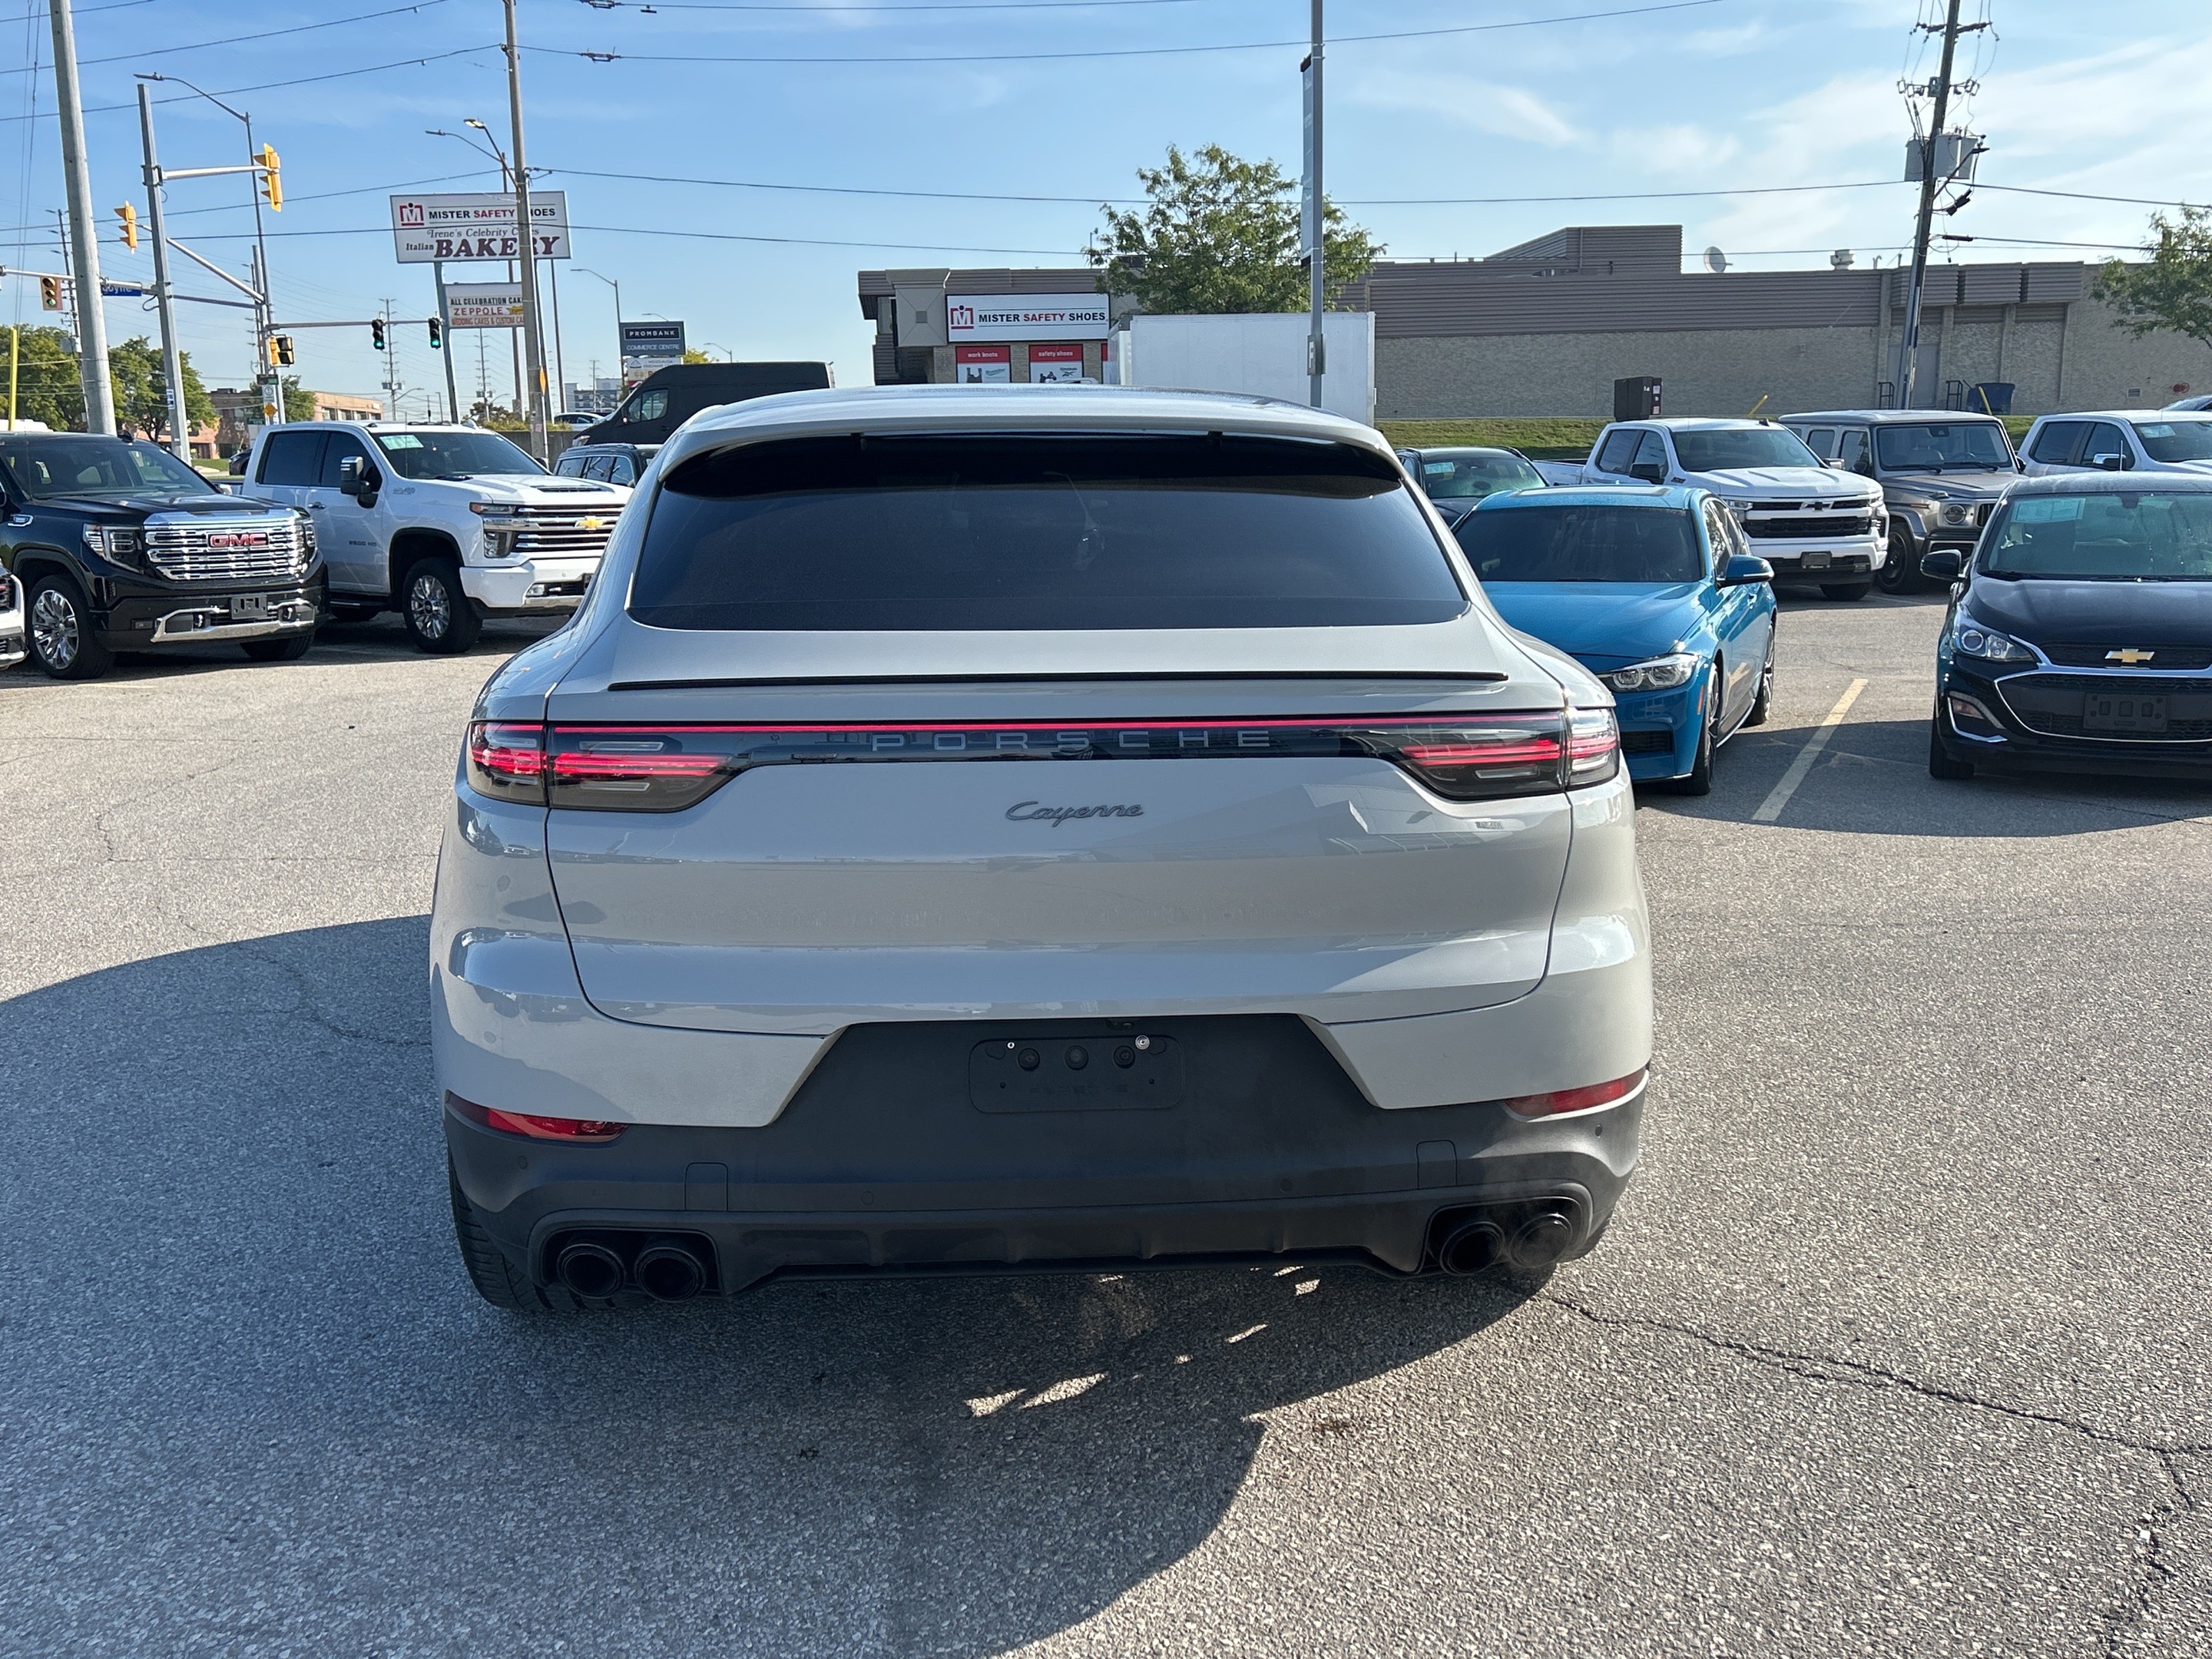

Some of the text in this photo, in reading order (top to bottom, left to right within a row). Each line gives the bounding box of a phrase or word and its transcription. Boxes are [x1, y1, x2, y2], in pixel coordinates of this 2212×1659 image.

[429, 210, 470, 219] MISTER
[474, 209, 515, 218] SAFETY
[426, 229, 462, 238] Irene's
[465, 227, 508, 237] Celebrity
[406, 243, 434, 251] Italian
[463, 297, 506, 306] CELEBRATION
[454, 306, 503, 316] ZEPPOLE
[979, 313, 1020, 323] MISTER
[1023, 313, 1065, 322] SAFETY
[1068, 312, 1106, 321] SHOES
[210, 533, 267, 547] GMC
[872, 730, 1270, 752] PORSCHE
[1005, 800, 1144, 828] Cayenne
